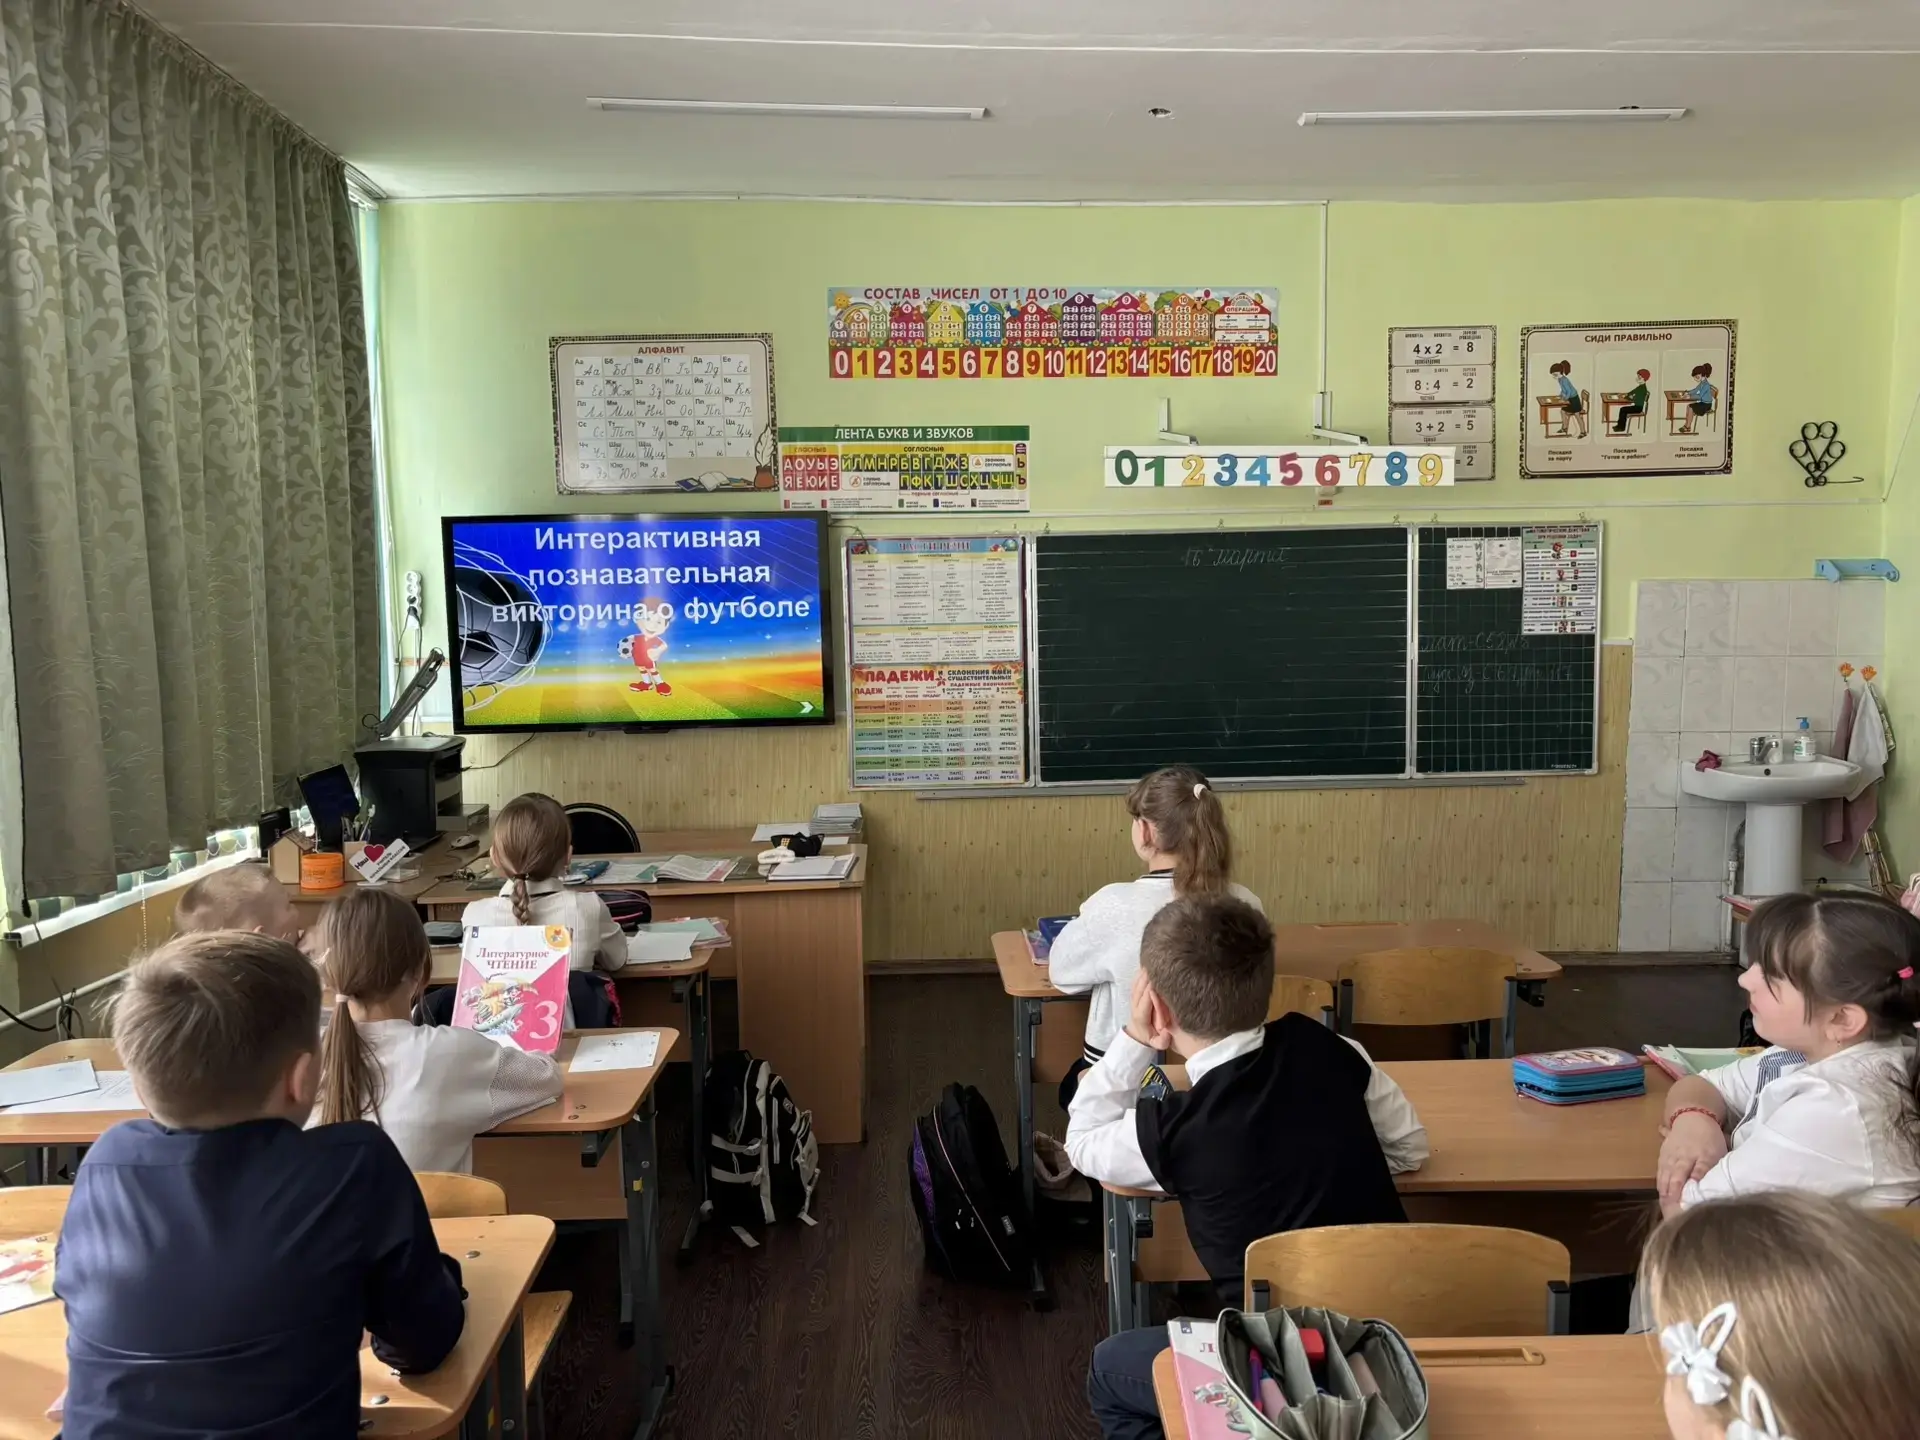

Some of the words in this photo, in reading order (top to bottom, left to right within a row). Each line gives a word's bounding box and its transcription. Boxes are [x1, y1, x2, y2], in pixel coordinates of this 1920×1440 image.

[864, 288, 920, 299] СОСТАВ
[931, 288, 979, 299] ЧИСЕЛ
[990, 288, 1008, 299] ОТ
[1013, 288, 1019, 299] 1
[1026, 288, 1049, 301] ДО
[1052, 288, 1067, 299] 10
[1584, 334, 1611, 343] СИДИ
[1613, 332, 1672, 342] ПРАВИЛЬНО
[638, 346, 685, 354] АЛФАВИТ
[1413, 344, 1420, 354] 4
[1435, 344, 1442, 354] 2
[1466, 342, 1474, 352] 8
[835, 351, 848, 375] 0
[857, 351, 867, 375] 1
[878, 350, 891, 375] 2
[899, 350, 913, 375] 3
[921, 350, 934, 374] 4
[942, 350, 955, 374] 5
[963, 350, 976, 374] 6
[985, 350, 998, 374] 7
[1006, 350, 1019, 374] 8
[1027, 350, 1040, 374] 9
[1045, 350, 1063, 374] 10
[1066, 350, 1082, 374] 11
[1086, 350, 1106, 374] 12
[1108, 350, 1127, 374] 13
[1129, 350, 1148, 374] 14
[1150, 350, 1170, 374] 15
[1171, 350, 1190, 374] 16
[1192, 350, 1212, 374] 17
[1214, 350, 1232, 374] 18
[1234, 350, 1254, 374] 19
[1256, 350, 1276, 373] 20
[1415, 380, 1421, 390] 8
[1433, 380, 1440, 390] 4
[1466, 378, 1473, 388] 2
[1416, 422, 1422, 432] 3
[1438, 422, 1444, 432] 2
[1467, 420, 1474, 430] 5
[835, 429, 874, 439] ЛЕНТА
[878, 428, 909, 438] БУКВ
[914, 428, 922, 438] И
[926, 428, 973, 438] ЗВУКОВ
[1466, 456, 1474, 466] 2
[1114, 450, 1138, 485] 0
[1144, 456, 1164, 486] 1
[1181, 455, 1205, 486] 2
[1214, 454, 1238, 486] 3
[1244, 455, 1271, 486] 4
[1278, 452, 1303, 485] 5
[1314, 454, 1341, 486] 6
[1349, 453, 1372, 486] 7
[1384, 451, 1408, 486] 8
[1417, 453, 1443, 486] 9
[534, 527, 761, 554] Интерактивная
[529, 561, 771, 586] познавательная
[492, 602, 648, 623] викторина
[656, 602, 674, 619] о
[683, 596, 811, 625] футболе
[866, 669, 935, 684] ПАДЕЖИ
[476, 948, 549, 959] Литературное
[487, 960, 537, 969] ЧТЕНИЕ
[529, 1000, 558, 1040] 3
